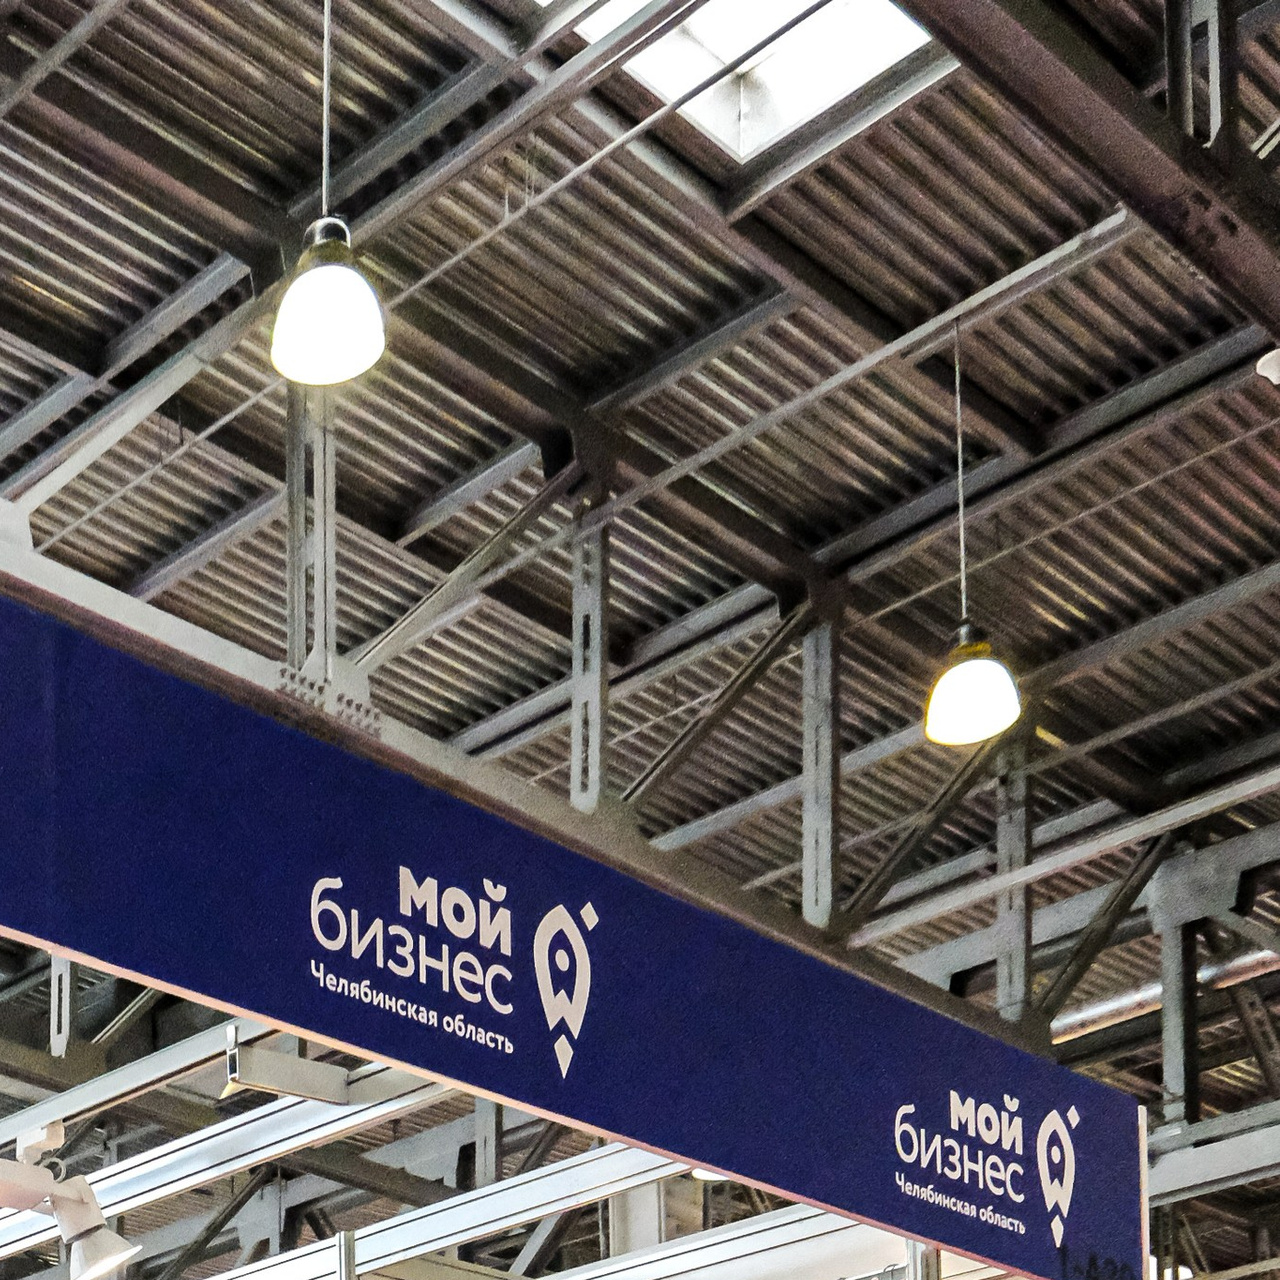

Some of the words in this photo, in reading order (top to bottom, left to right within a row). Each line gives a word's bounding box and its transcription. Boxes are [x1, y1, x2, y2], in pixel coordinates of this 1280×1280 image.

[310, 877, 513, 1014] бизнес
[311, 959, 438, 1026] Челябинская
[443, 1013, 514, 1054] область
[894, 1104, 1025, 1203] бизнес
[895, 1171, 977, 1218] Челябинская
[979, 1205, 1026, 1235] область
